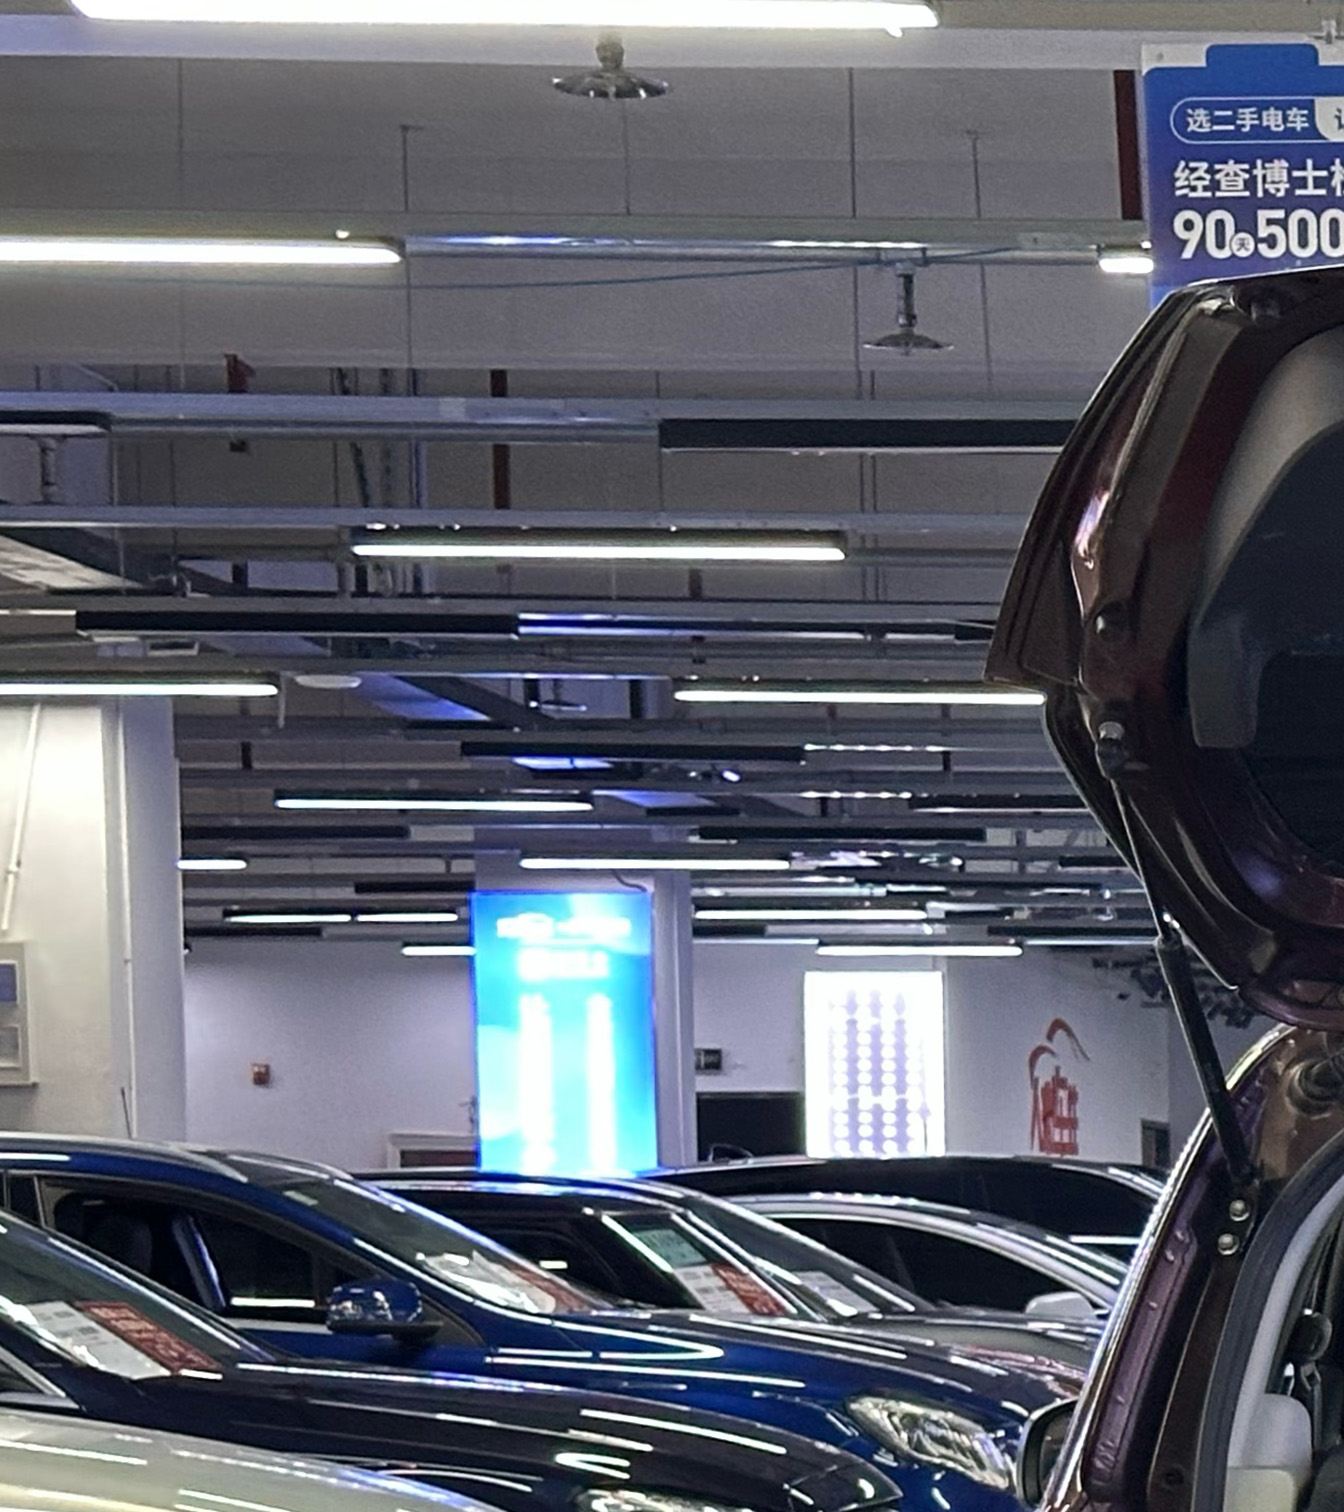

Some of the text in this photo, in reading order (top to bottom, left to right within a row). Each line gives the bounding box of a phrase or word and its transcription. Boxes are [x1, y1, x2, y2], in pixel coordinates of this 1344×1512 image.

[1185, 106, 1310, 134] 选二手电车
